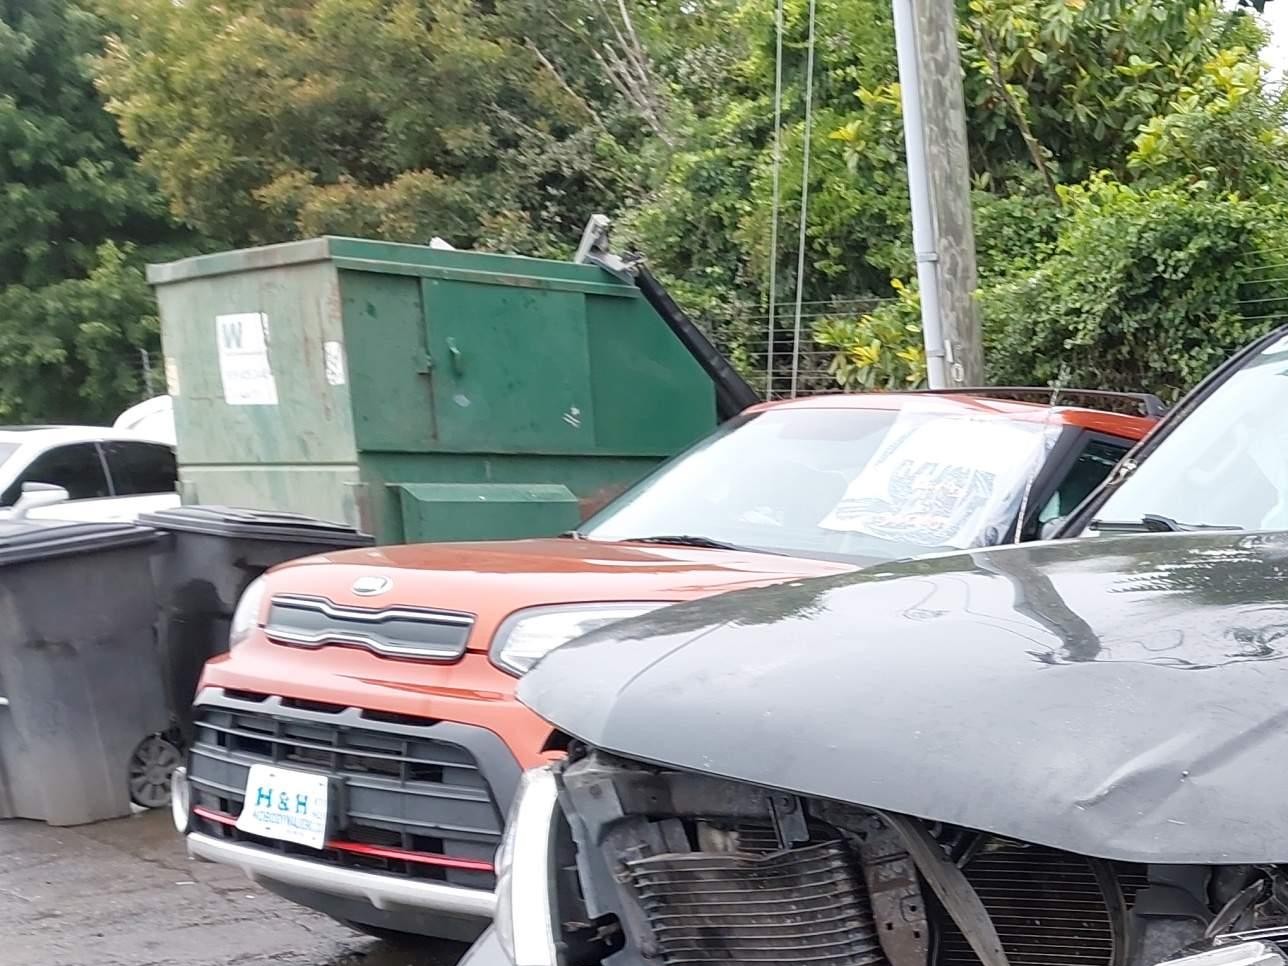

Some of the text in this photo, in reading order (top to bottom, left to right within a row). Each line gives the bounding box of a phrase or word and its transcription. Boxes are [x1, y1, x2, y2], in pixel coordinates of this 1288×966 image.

[256, 786, 273, 808] H
[278, 791, 289, 811] &
[296, 793, 308, 815] H
